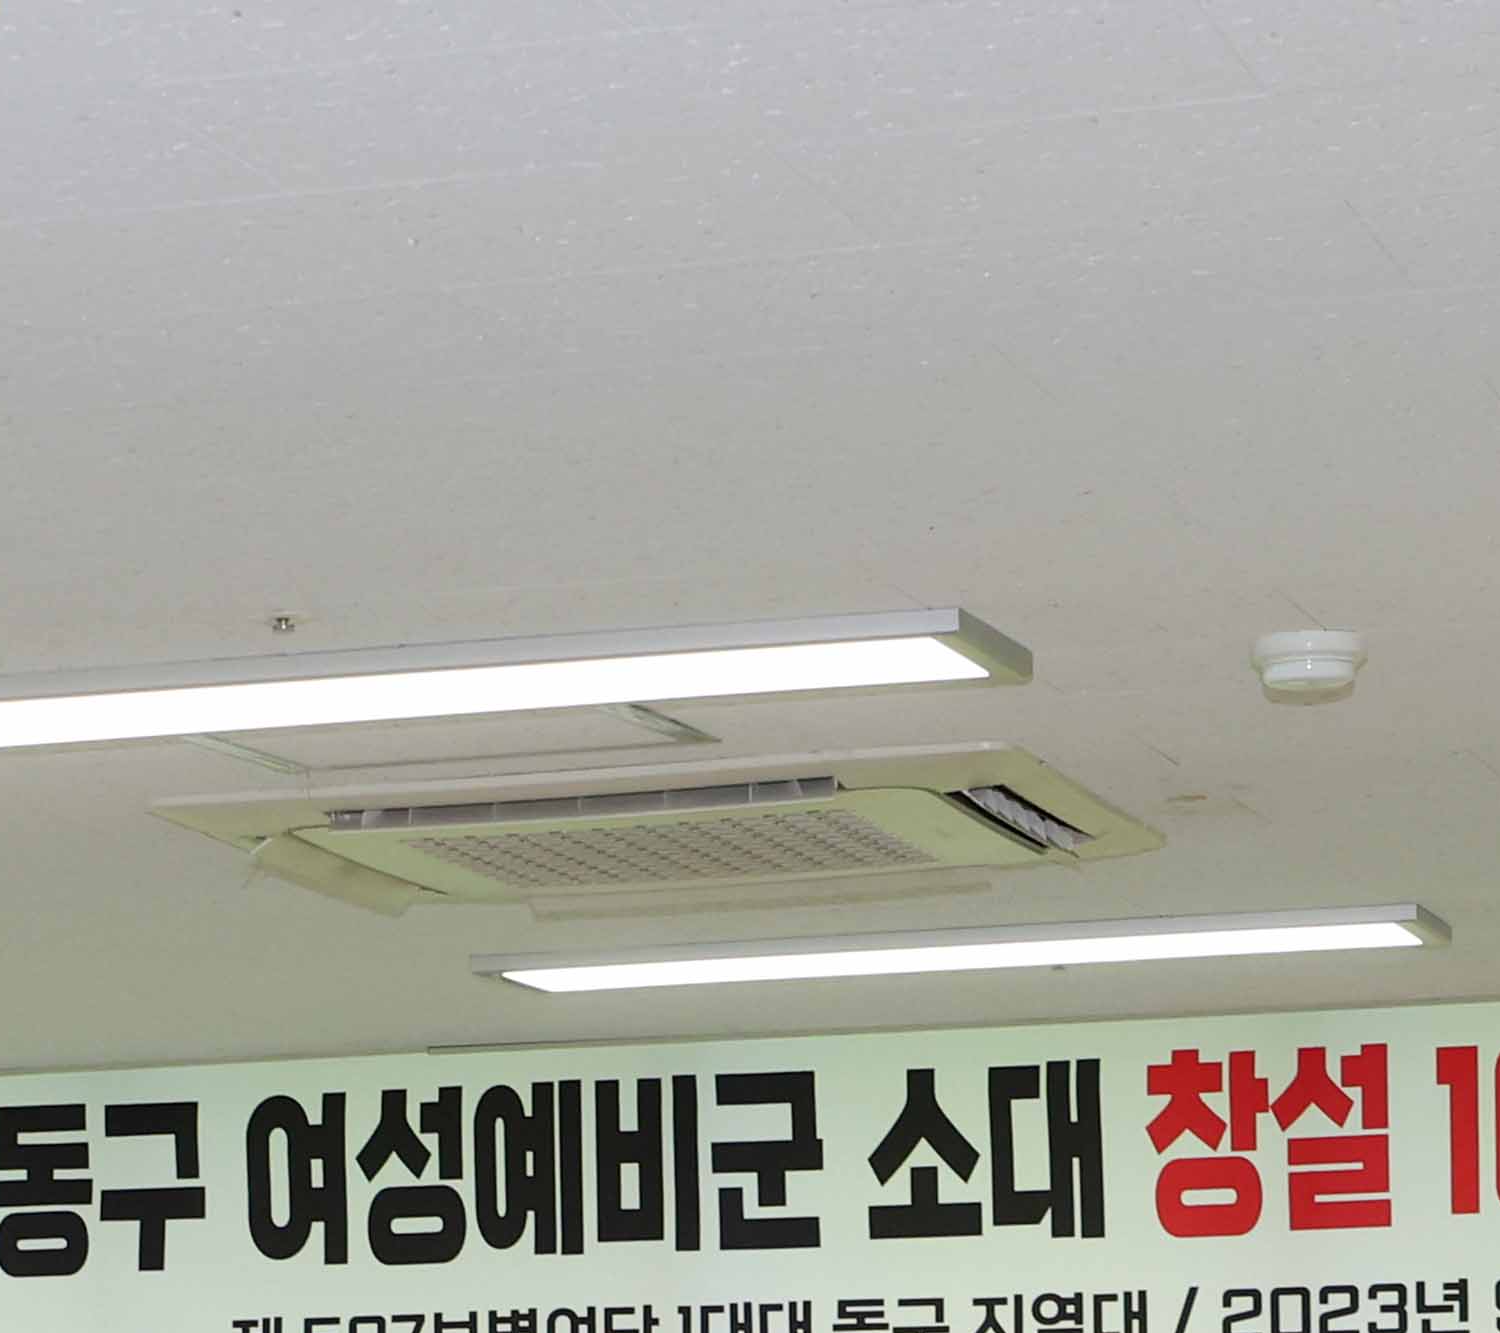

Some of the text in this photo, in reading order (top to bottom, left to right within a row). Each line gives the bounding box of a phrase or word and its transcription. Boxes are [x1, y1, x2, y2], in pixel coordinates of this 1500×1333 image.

[246, 1071, 823, 1266] 여성예비군
[868, 1058, 1106, 1241] 소대
[1145, 1044, 1392, 1238] 창설
